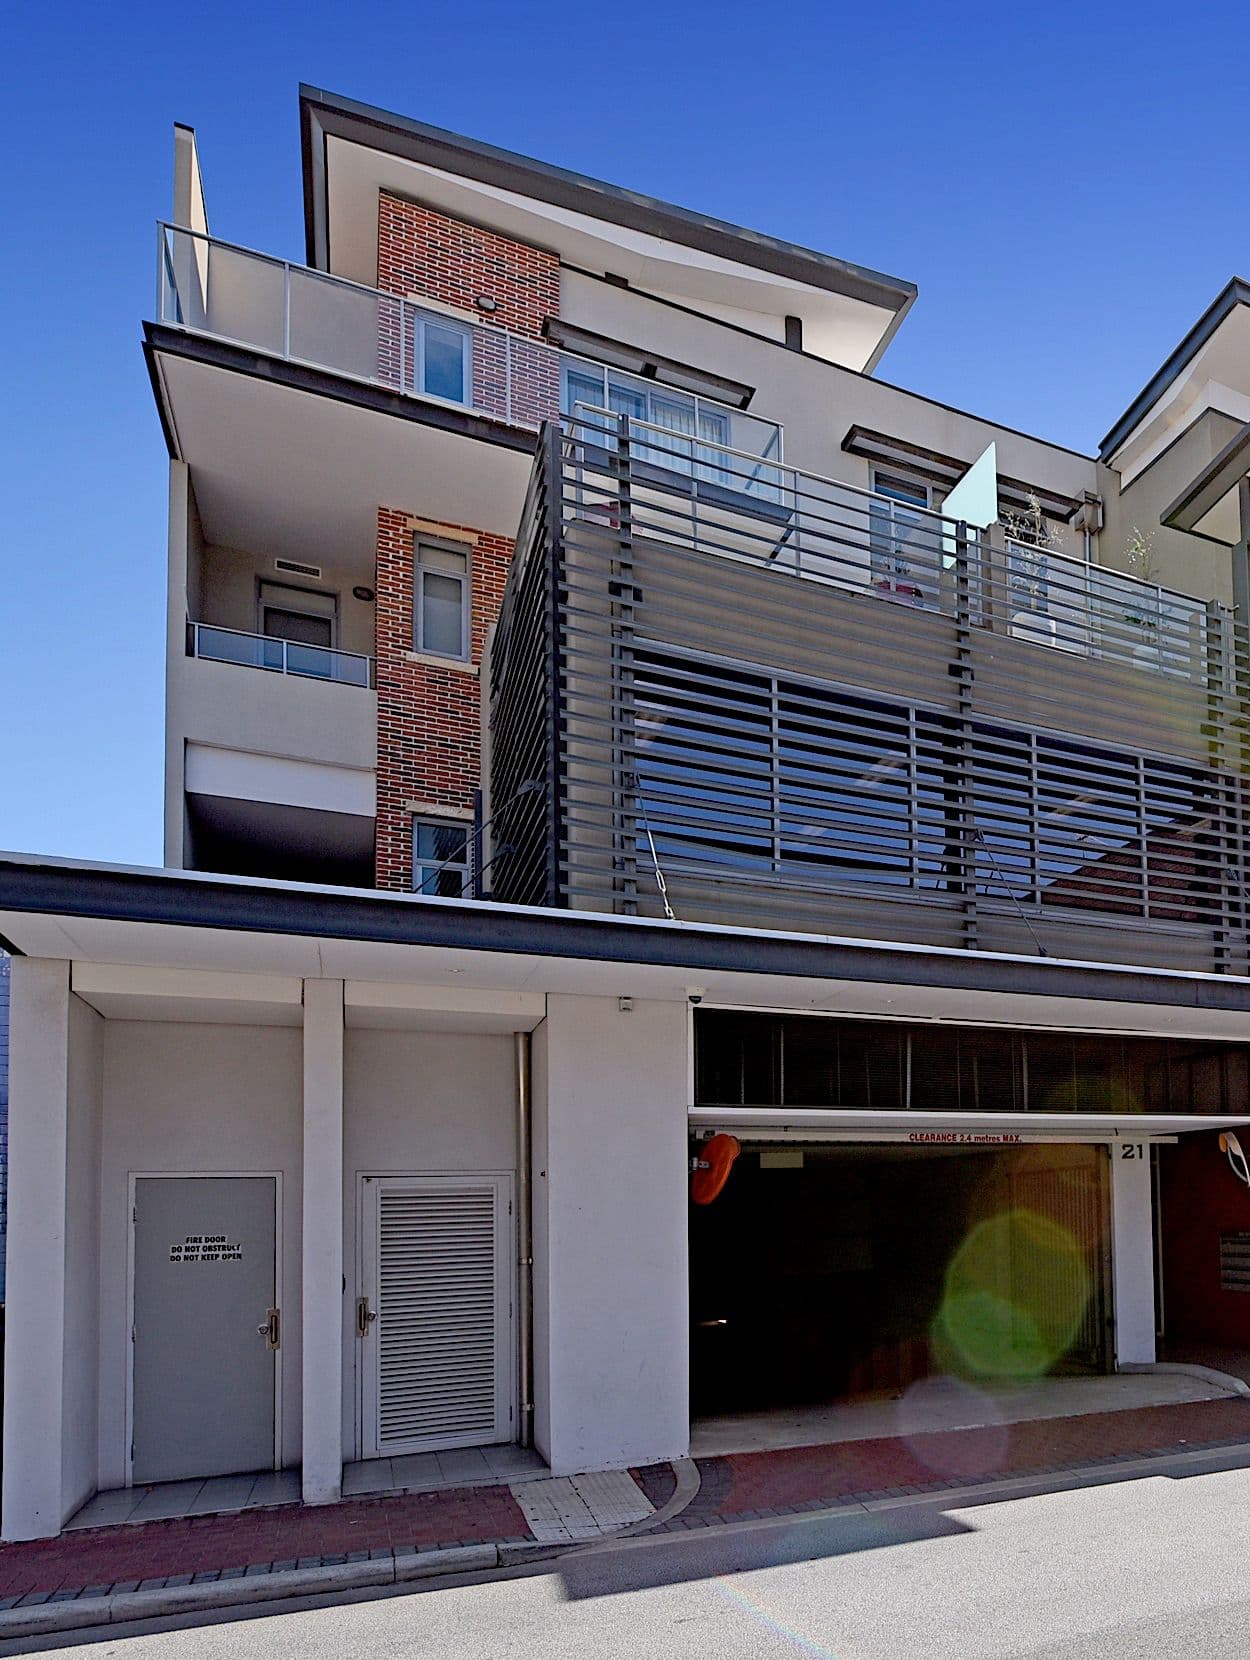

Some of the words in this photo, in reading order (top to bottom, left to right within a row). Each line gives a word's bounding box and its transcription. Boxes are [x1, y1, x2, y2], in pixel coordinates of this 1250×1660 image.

[909, 1133, 957, 1142] CLEARANCE
[959, 1134, 971, 1142] 2.4
[1121, 1143, 1143, 1160] 21
[185, 1236, 203, 1244] FIRE
[171, 1245, 183, 1253] DO
[185, 1245, 200, 1253] NOT
[202, 1243, 241, 1252] OBSTRUCT
[183, 1254, 199, 1262] NOT
[201, 1253, 220, 1261] KEEP
